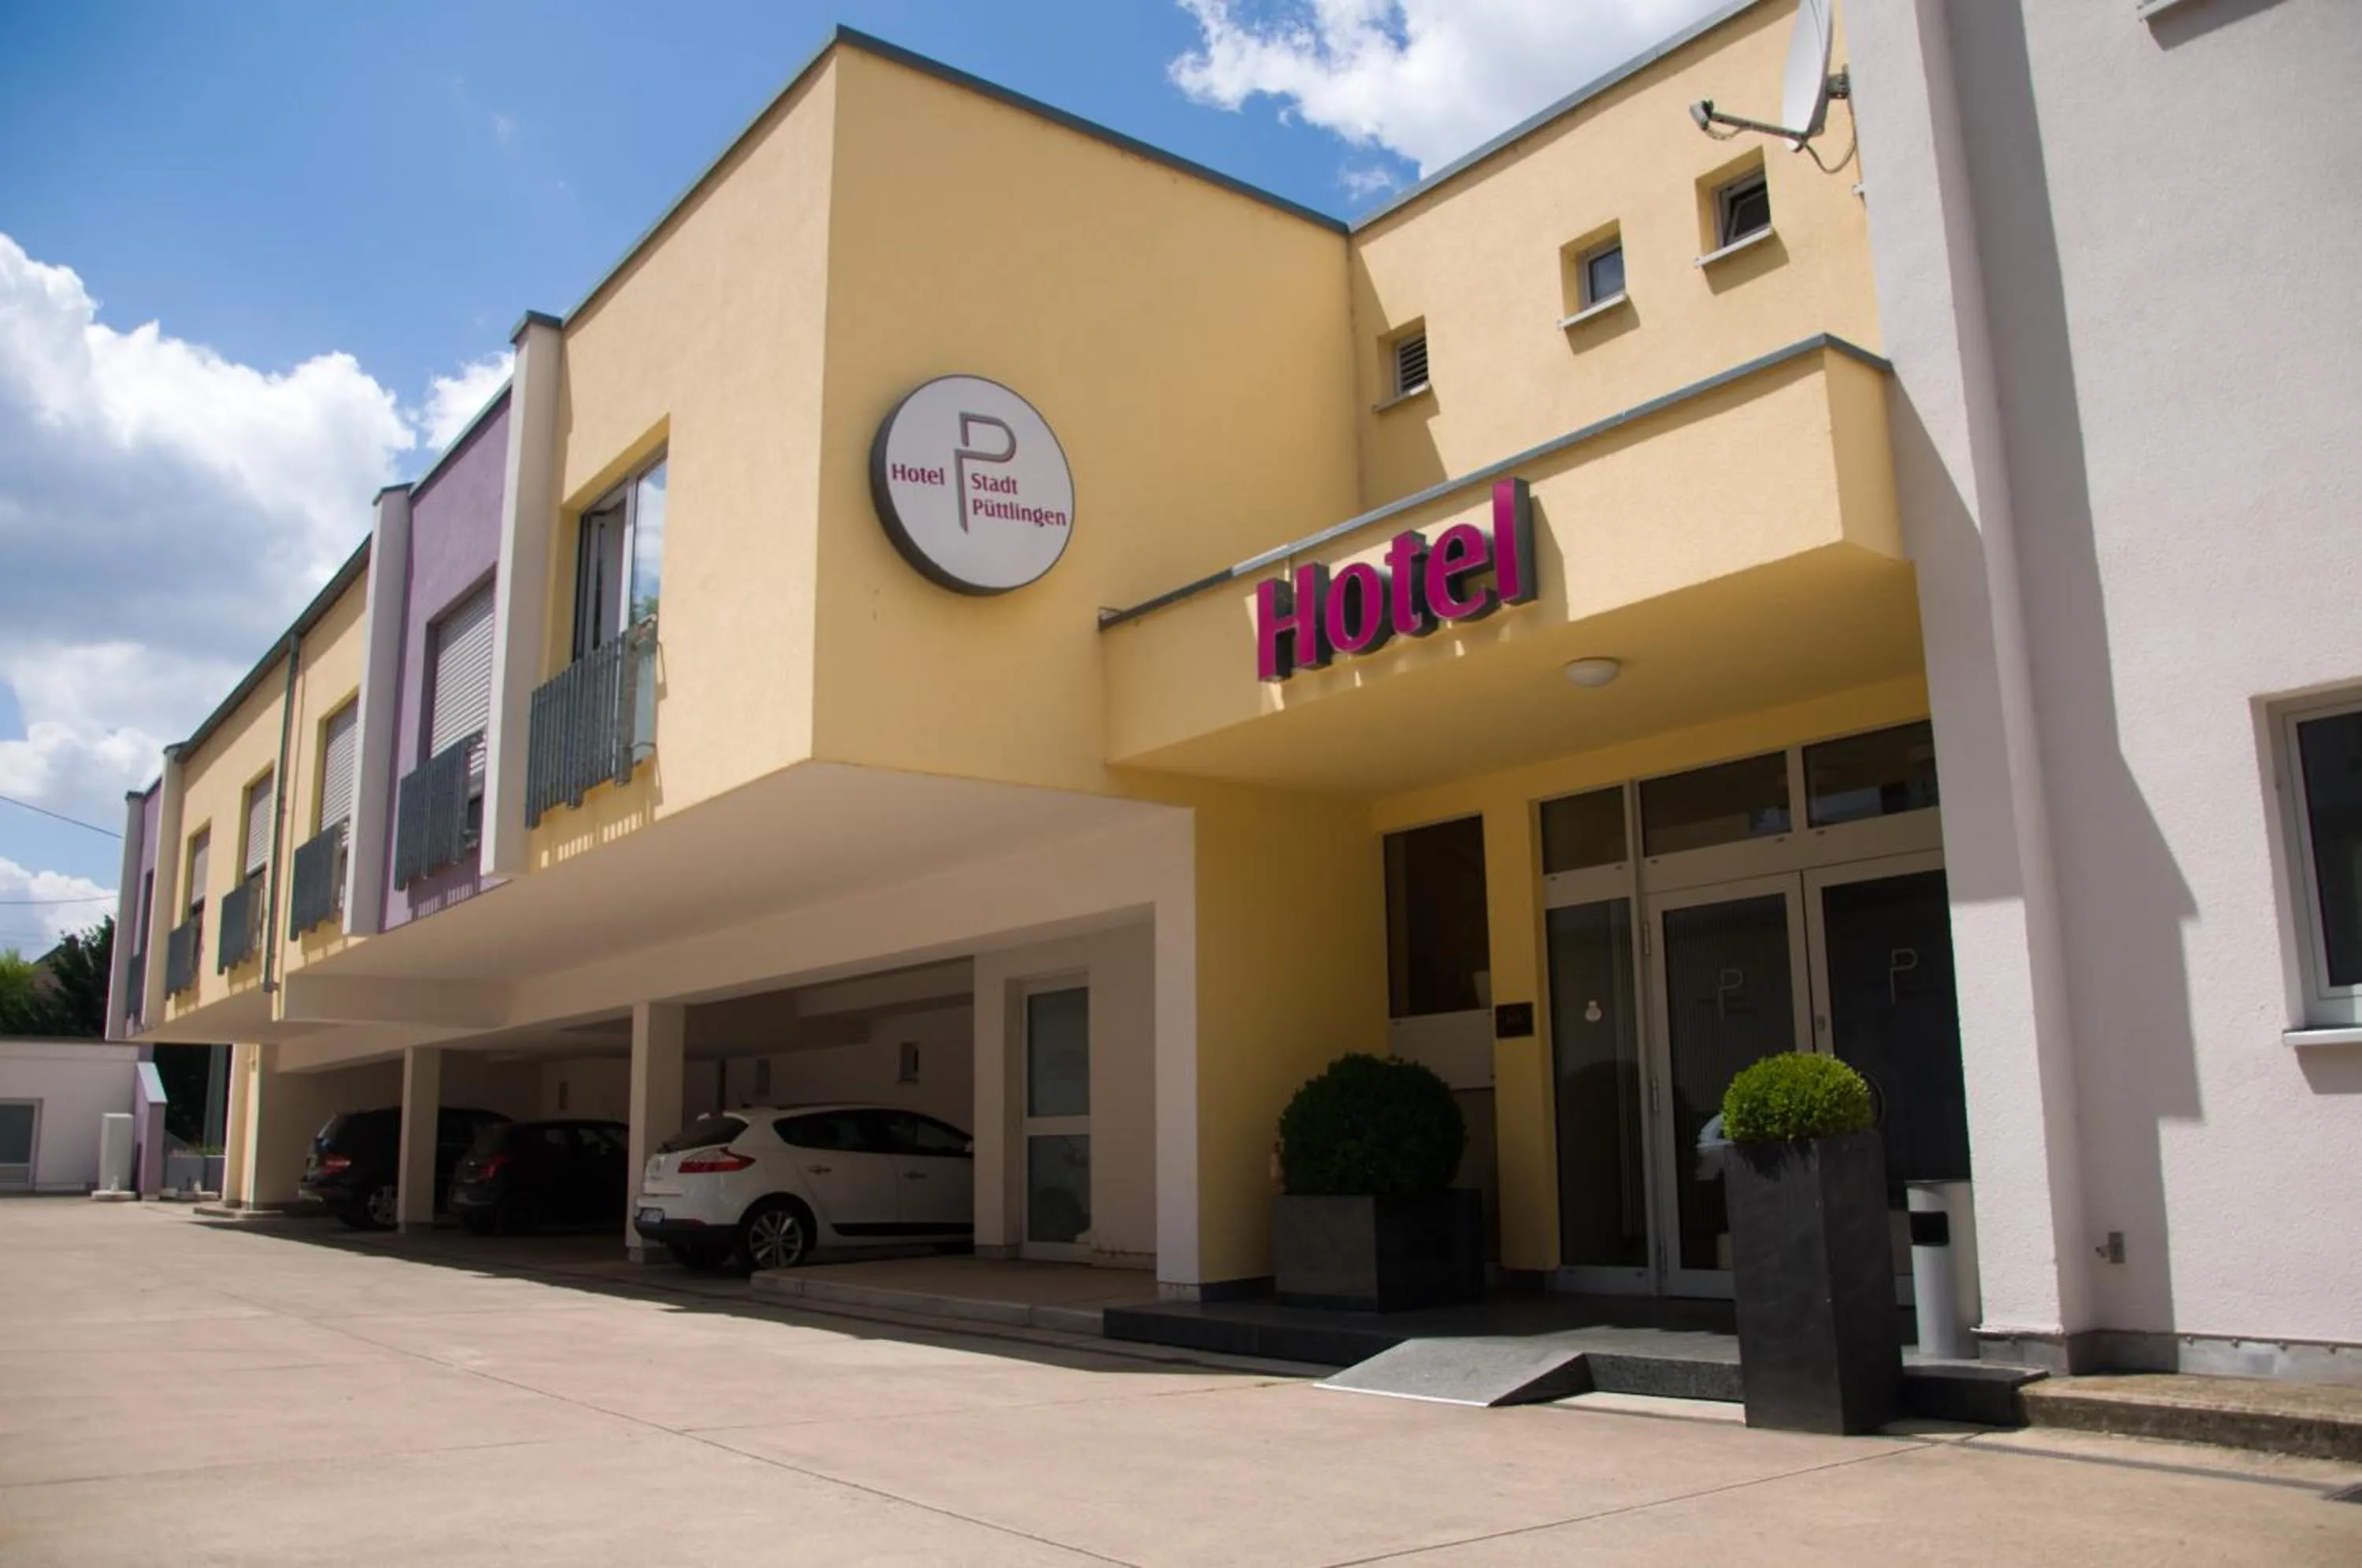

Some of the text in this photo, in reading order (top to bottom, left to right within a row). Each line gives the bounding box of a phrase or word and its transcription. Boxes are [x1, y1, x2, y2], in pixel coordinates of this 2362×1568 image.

[891, 463, 946, 486] Hotel
[970, 472, 1018, 495] Stadt
[972, 498, 1067, 527] Püttlingen
[1256, 476, 1523, 682] Hotel
